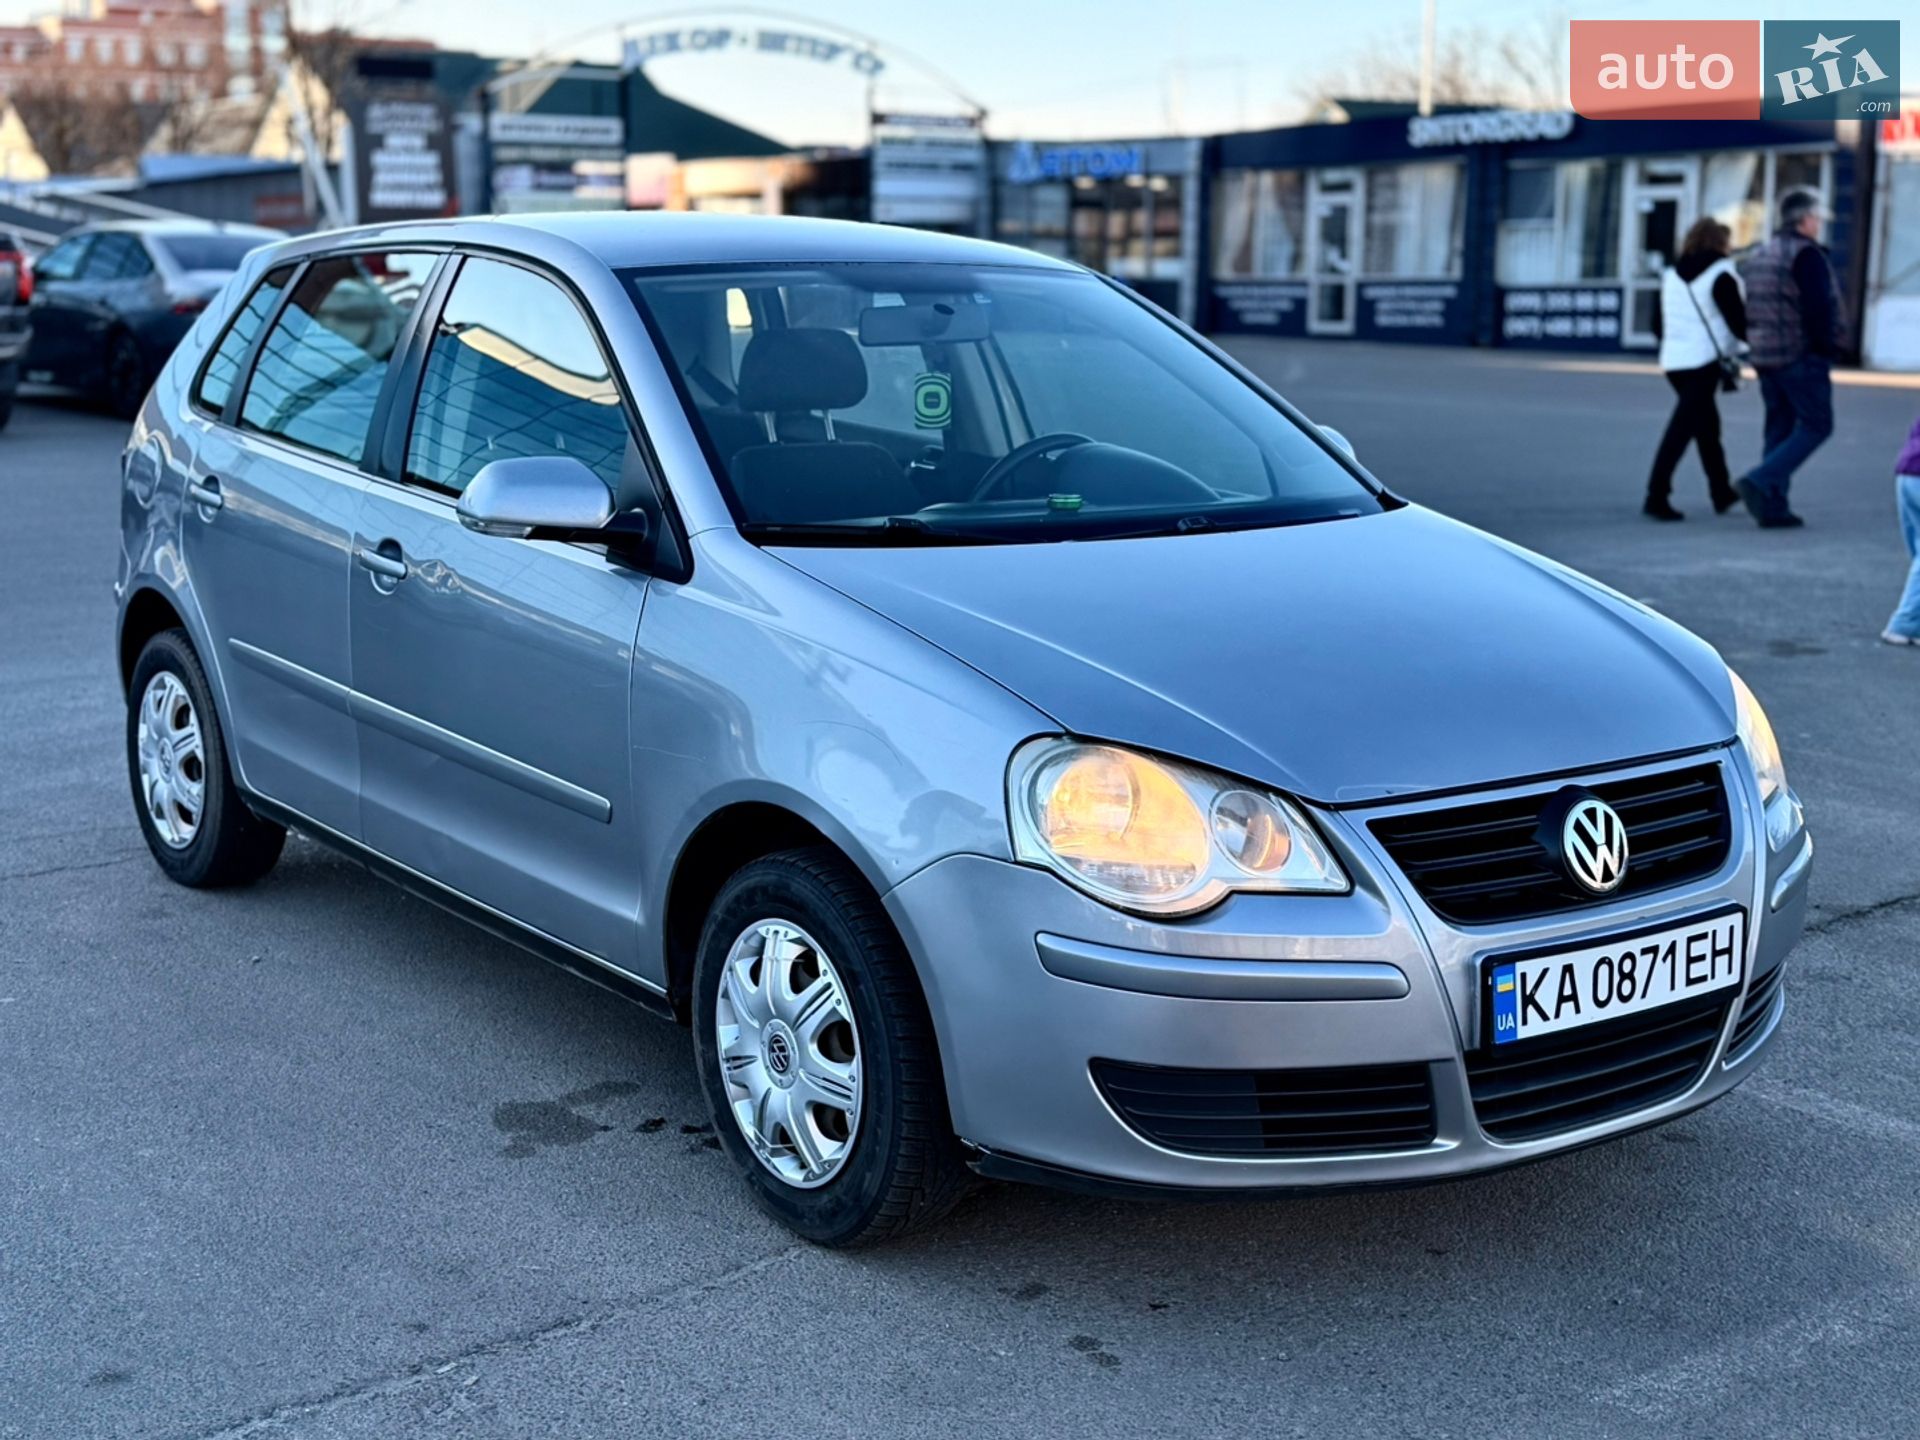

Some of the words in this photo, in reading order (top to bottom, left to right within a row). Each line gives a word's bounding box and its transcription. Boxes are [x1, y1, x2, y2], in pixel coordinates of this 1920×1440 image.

[1520, 963, 1581, 1026] KA
[1592, 940, 1677, 1009] 0871
[1686, 925, 1734, 987] EH
[1497, 1012, 1515, 1031] UA
